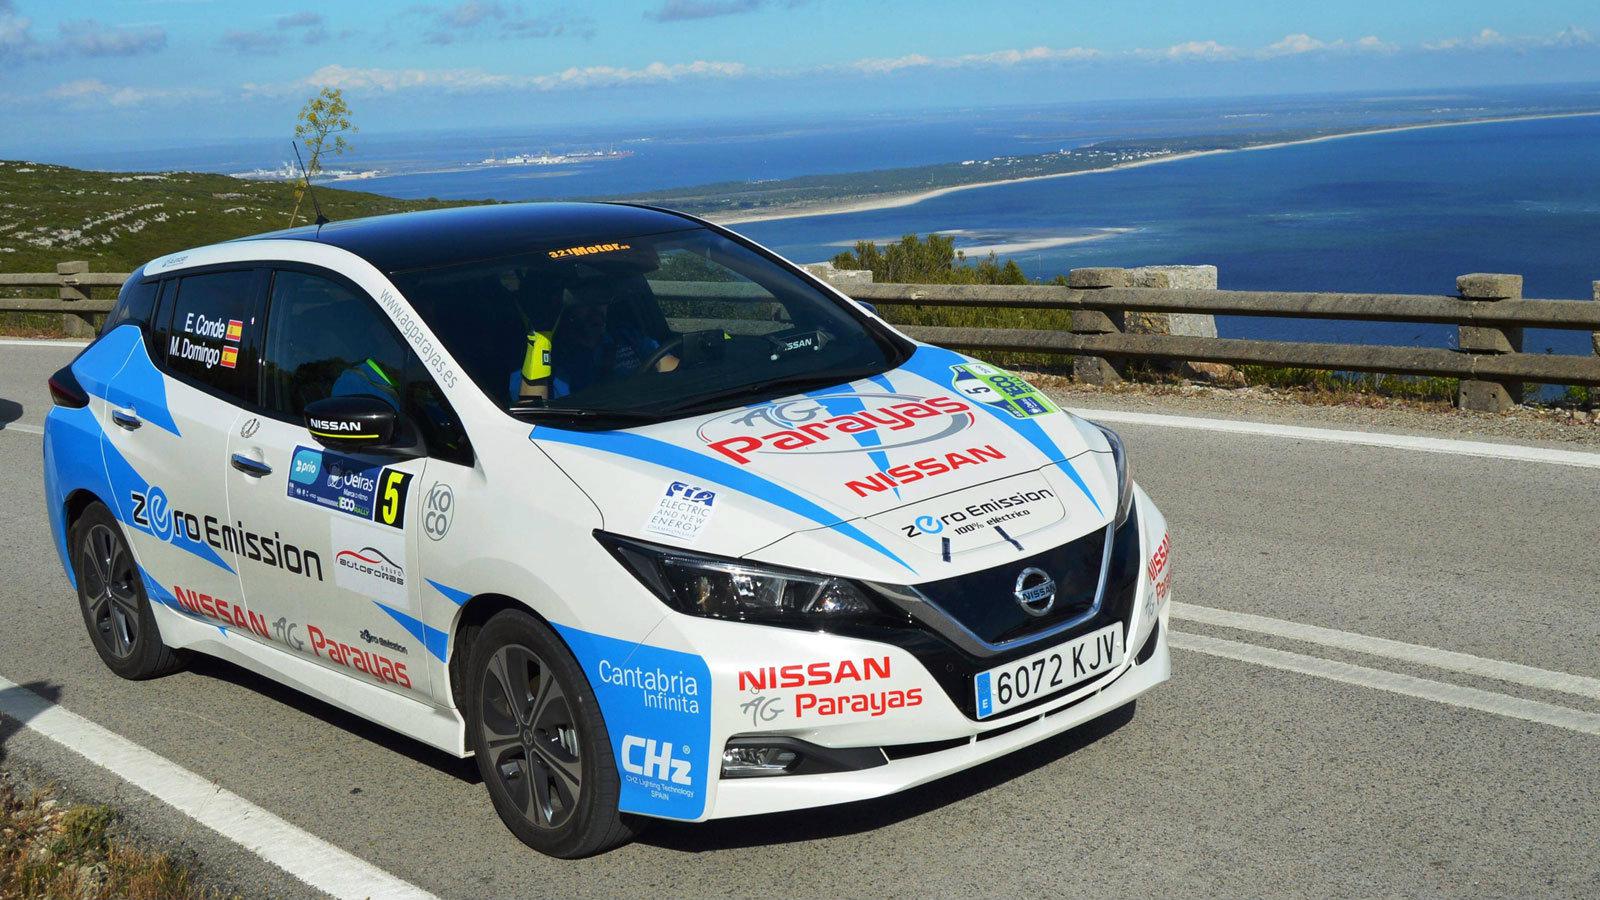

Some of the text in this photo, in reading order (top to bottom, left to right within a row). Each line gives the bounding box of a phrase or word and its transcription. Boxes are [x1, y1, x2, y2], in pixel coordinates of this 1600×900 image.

[184, 313, 226, 339] E. Conde
[380, 289, 458, 389] www.agparayas.es
[169, 336, 220, 369] M. Domingo
[310, 418, 361, 431] NISSAN
[730, 402, 828, 430] AG
[707, 396, 971, 465] Parayas
[344, 471, 374, 492] Oeiras
[844, 444, 1006, 498] NISSAN
[382, 471, 404, 525] 5
[660, 499, 711, 518] ELECTRIC
[966, 489, 1055, 517] Emission
[651, 516, 701, 532] ENERGY
[657, 509, 705, 525] AND NEW
[954, 508, 1031, 536] 100% eléctrico
[204, 515, 323, 582] Emission
[1022, 582, 1056, 601] NISSAN
[173, 586, 412, 689] NISSAN AG Parayas
[598, 659, 698, 696] Cantabria
[738, 656, 890, 691] NISSAN
[997, 631, 1115, 705] 6072 KJV
[644, 690, 699, 714] Infinita
[740, 688, 923, 727] AG Parayas
[982, 699, 989, 709] E
[650, 790, 669, 801] SPAIN
[661, 783, 694, 798] Technology
